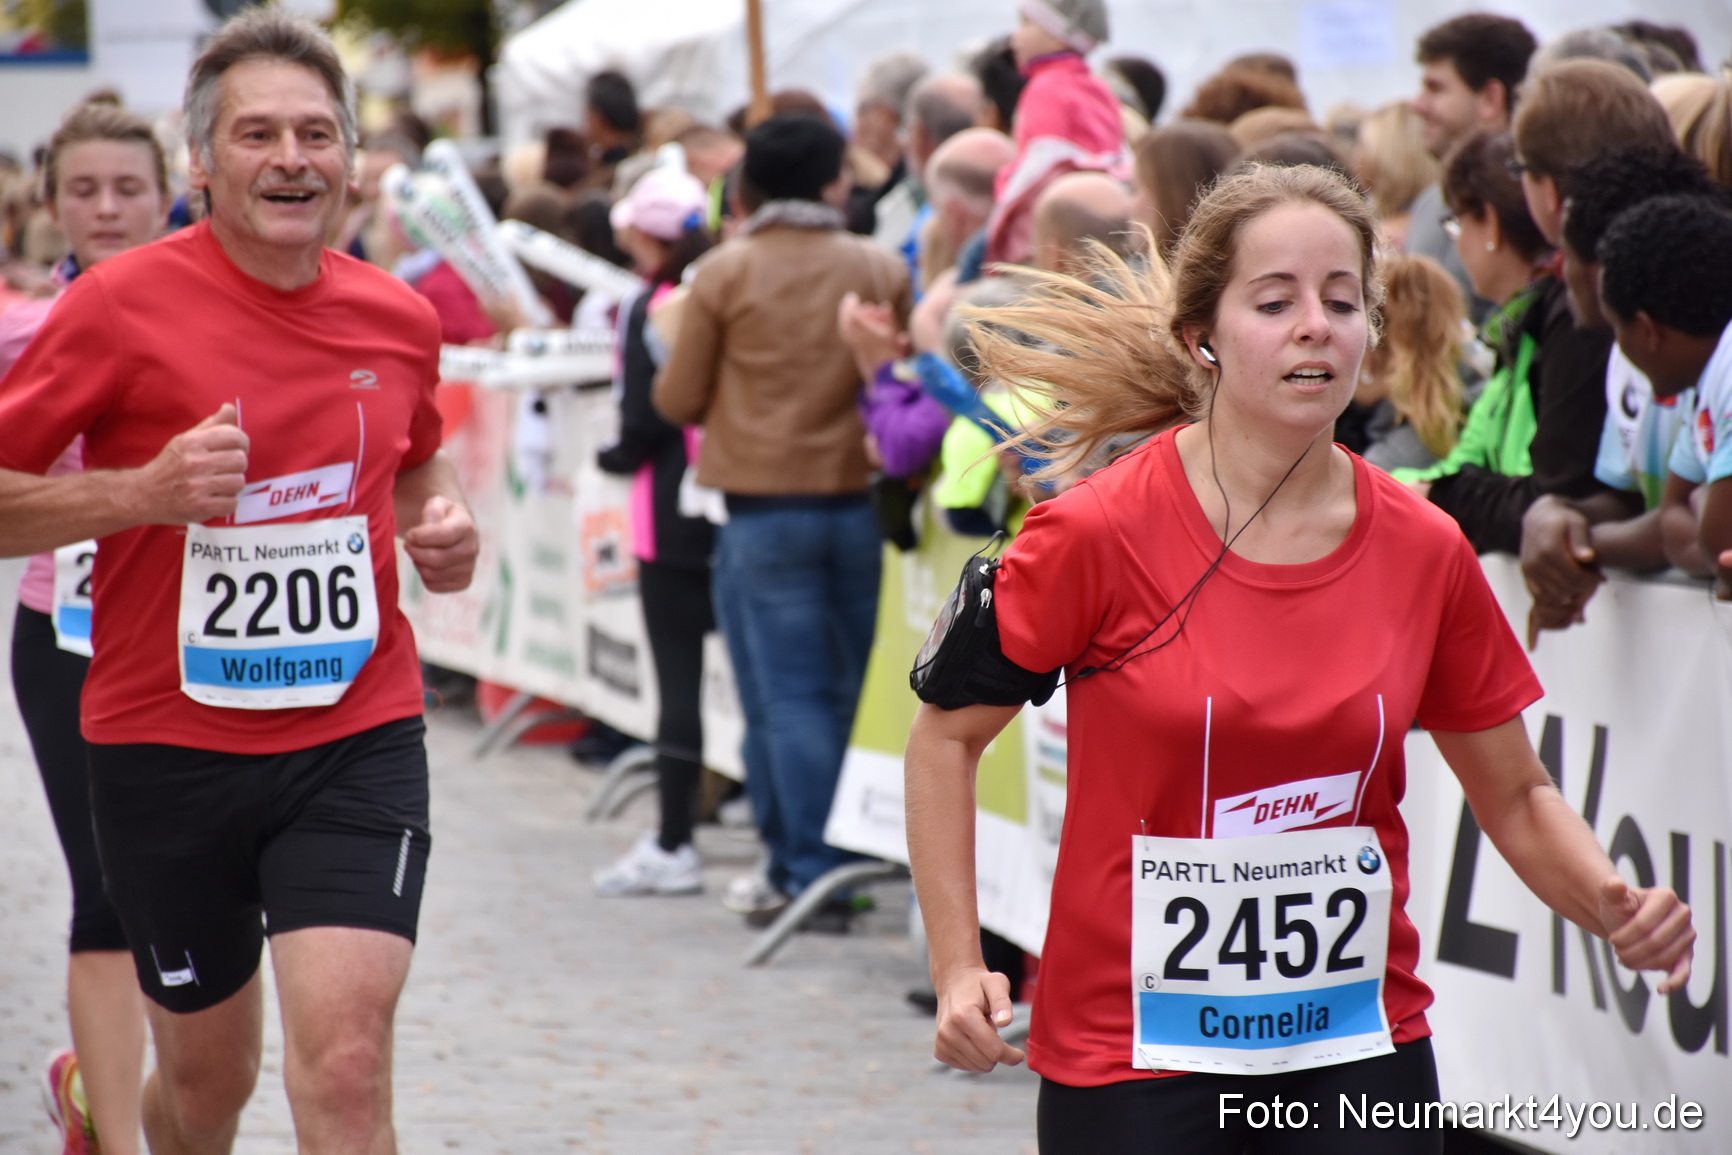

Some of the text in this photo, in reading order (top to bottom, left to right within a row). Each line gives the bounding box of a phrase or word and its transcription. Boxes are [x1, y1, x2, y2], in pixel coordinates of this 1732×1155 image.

[269, 481, 321, 507] DEHN
[191, 539, 341, 562] PARTL Neumarkt
[203, 565, 359, 638] 2206
[221, 656, 342, 686] Wolfgang
[1253, 791, 1319, 825] DEHN
[1141, 854, 1348, 883] PARTL Neumarkt
[1163, 887, 1368, 982] 2452
[1145, 975, 1155, 989] C
[1200, 1002, 1330, 1040] Cornelia
